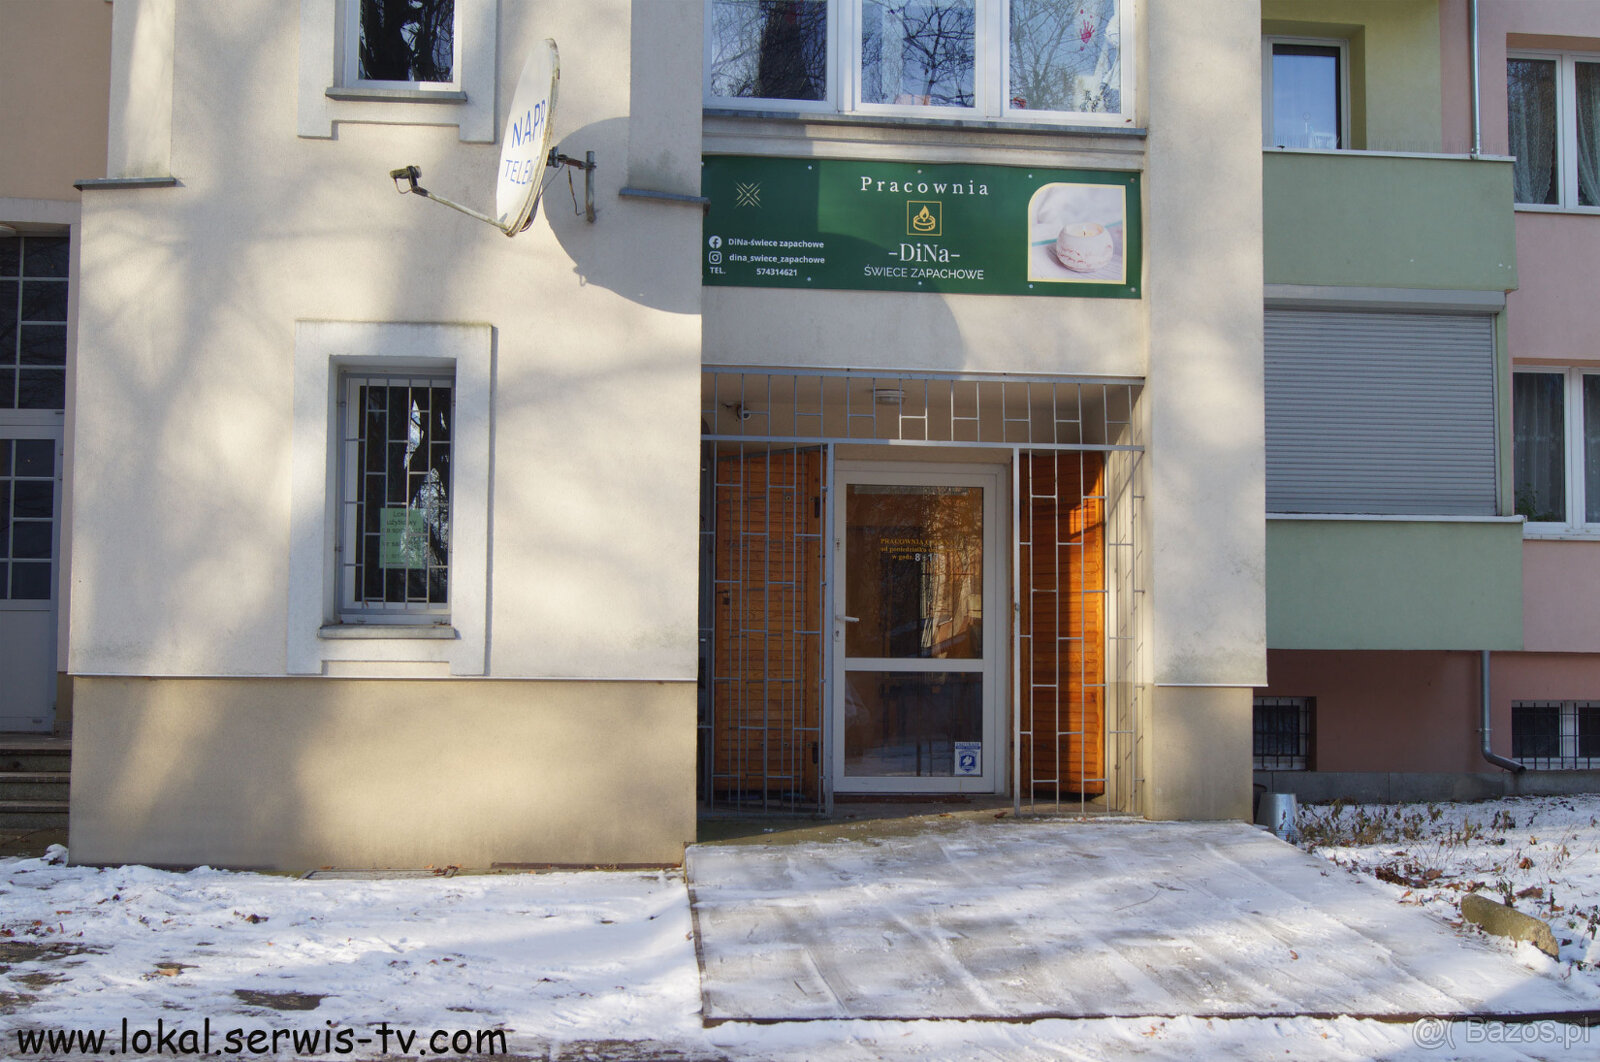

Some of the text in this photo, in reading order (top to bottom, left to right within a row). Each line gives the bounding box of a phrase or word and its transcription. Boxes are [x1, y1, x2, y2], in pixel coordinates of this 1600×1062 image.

[512, 97, 549, 148] NAPR
[860, 176, 989, 195] Pracownia
[728, 238, 824, 249] DiNa-świece zapachowe
[729, 253, 825, 265] dina_swiece_zapachowe
[710, 266, 797, 276] TEL. 574314621
[864, 264, 984, 280] ŚWIECE ZAPACHOWE
[880, 538, 923, 546] PRACOWNIA
[914, 553, 921, 562] 8
